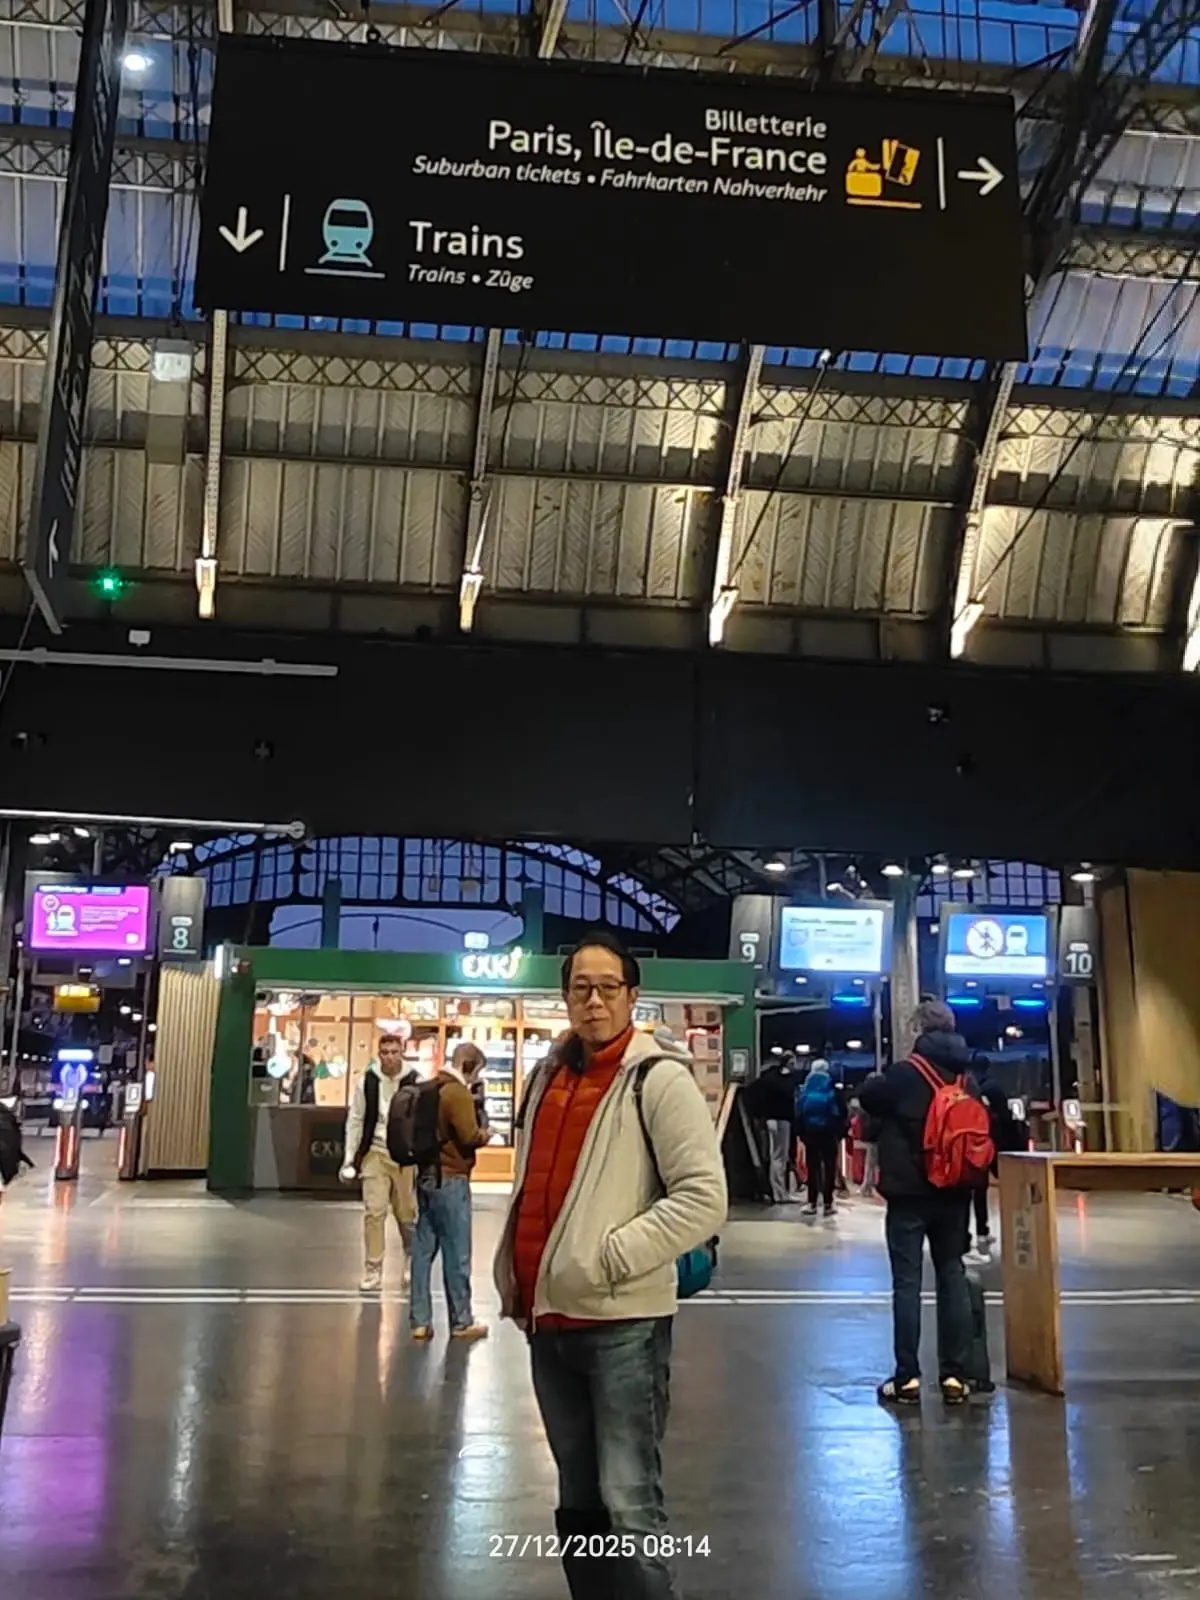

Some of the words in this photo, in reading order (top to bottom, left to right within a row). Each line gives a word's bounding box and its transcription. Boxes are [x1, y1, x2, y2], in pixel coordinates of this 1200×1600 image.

[706, 108, 828, 139] Billetterie
[488, 119, 582, 163] Paris,
[591, 119, 828, 175] Île-de-France
[412, 155, 511, 181] Suburban
[516, 163, 582, 186] tickets
[600, 168, 709, 194] Fahrkarten
[713, 176, 828, 203] Nahverkehr
[409, 221, 524, 259] Trains
[408, 264, 467, 285] Trains
[485, 269, 534, 293] Züge
[172, 927, 189, 949] 8
[741, 943, 756, 963] 9
[1065, 952, 1093, 974] 10
